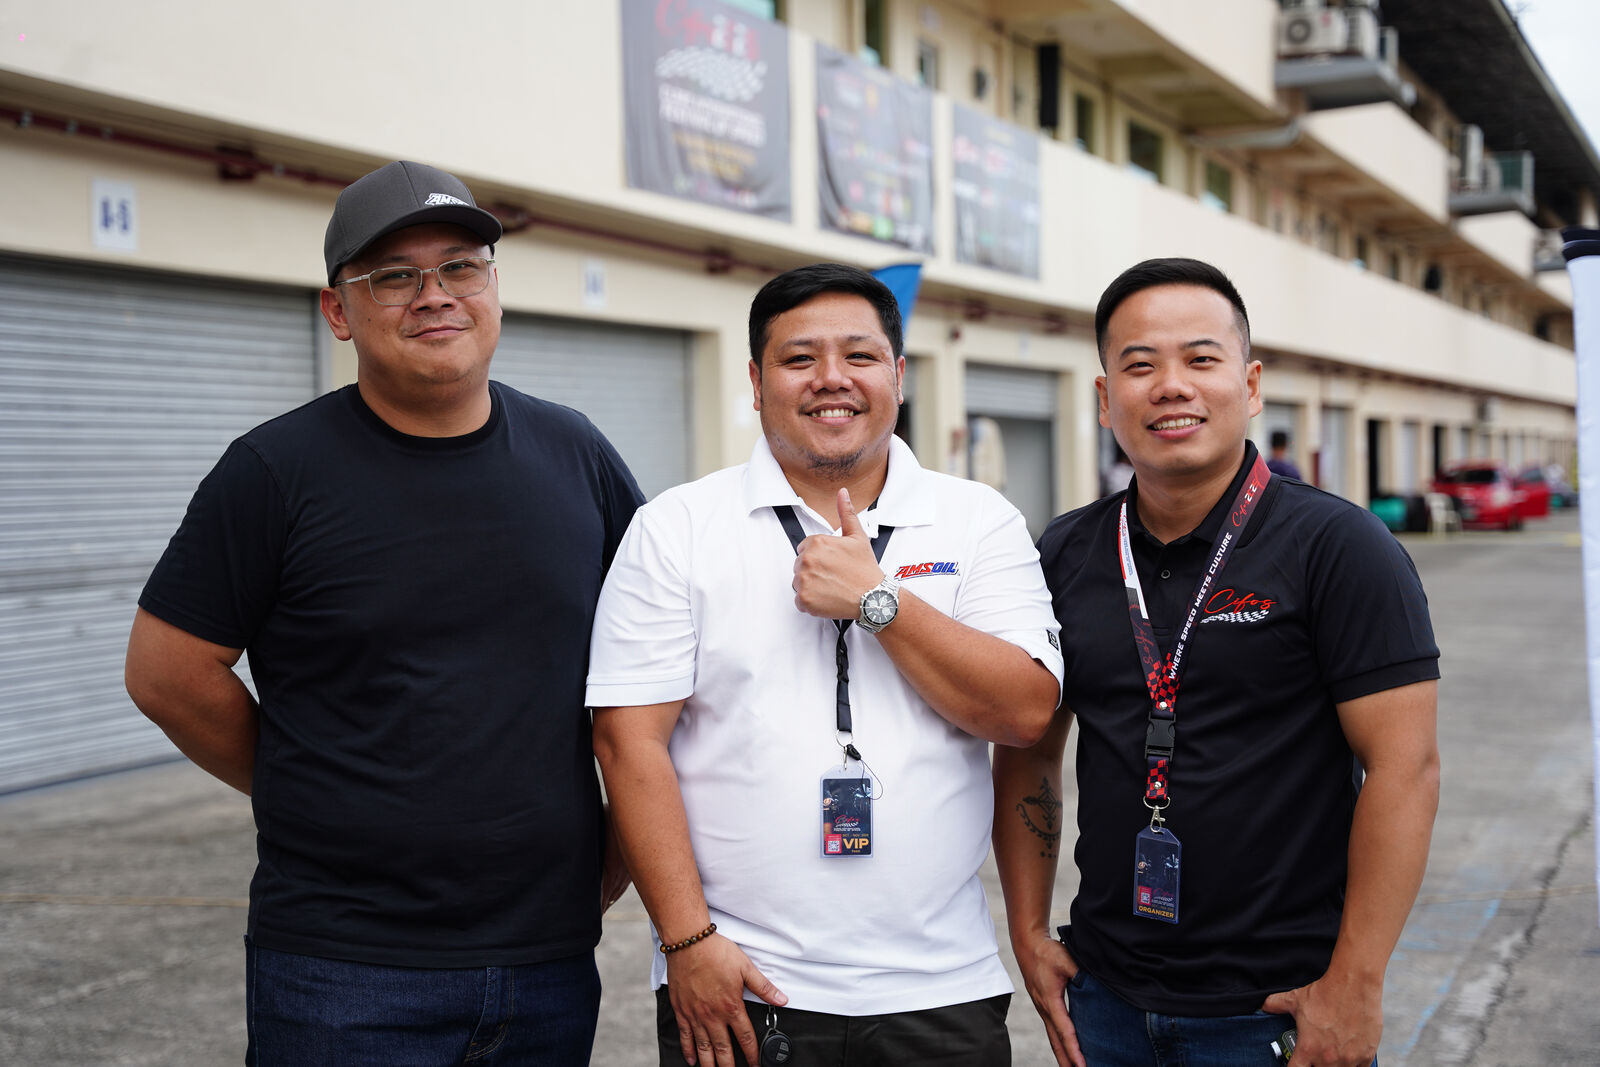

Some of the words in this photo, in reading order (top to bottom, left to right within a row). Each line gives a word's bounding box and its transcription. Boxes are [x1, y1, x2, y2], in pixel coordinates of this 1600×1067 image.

[894, 562, 958, 579] AMSOIL
[1168, 642, 1185, 679] WHERE
[1181, 609, 1197, 641] SPEED
[1195, 575, 1212, 607] MEETS
[1209, 532, 1233, 575] CULTURE
[1204, 589, 1277, 614] Cifos
[843, 838, 869, 849] VIP
[1138, 905, 1174, 918] ORGANIZER
